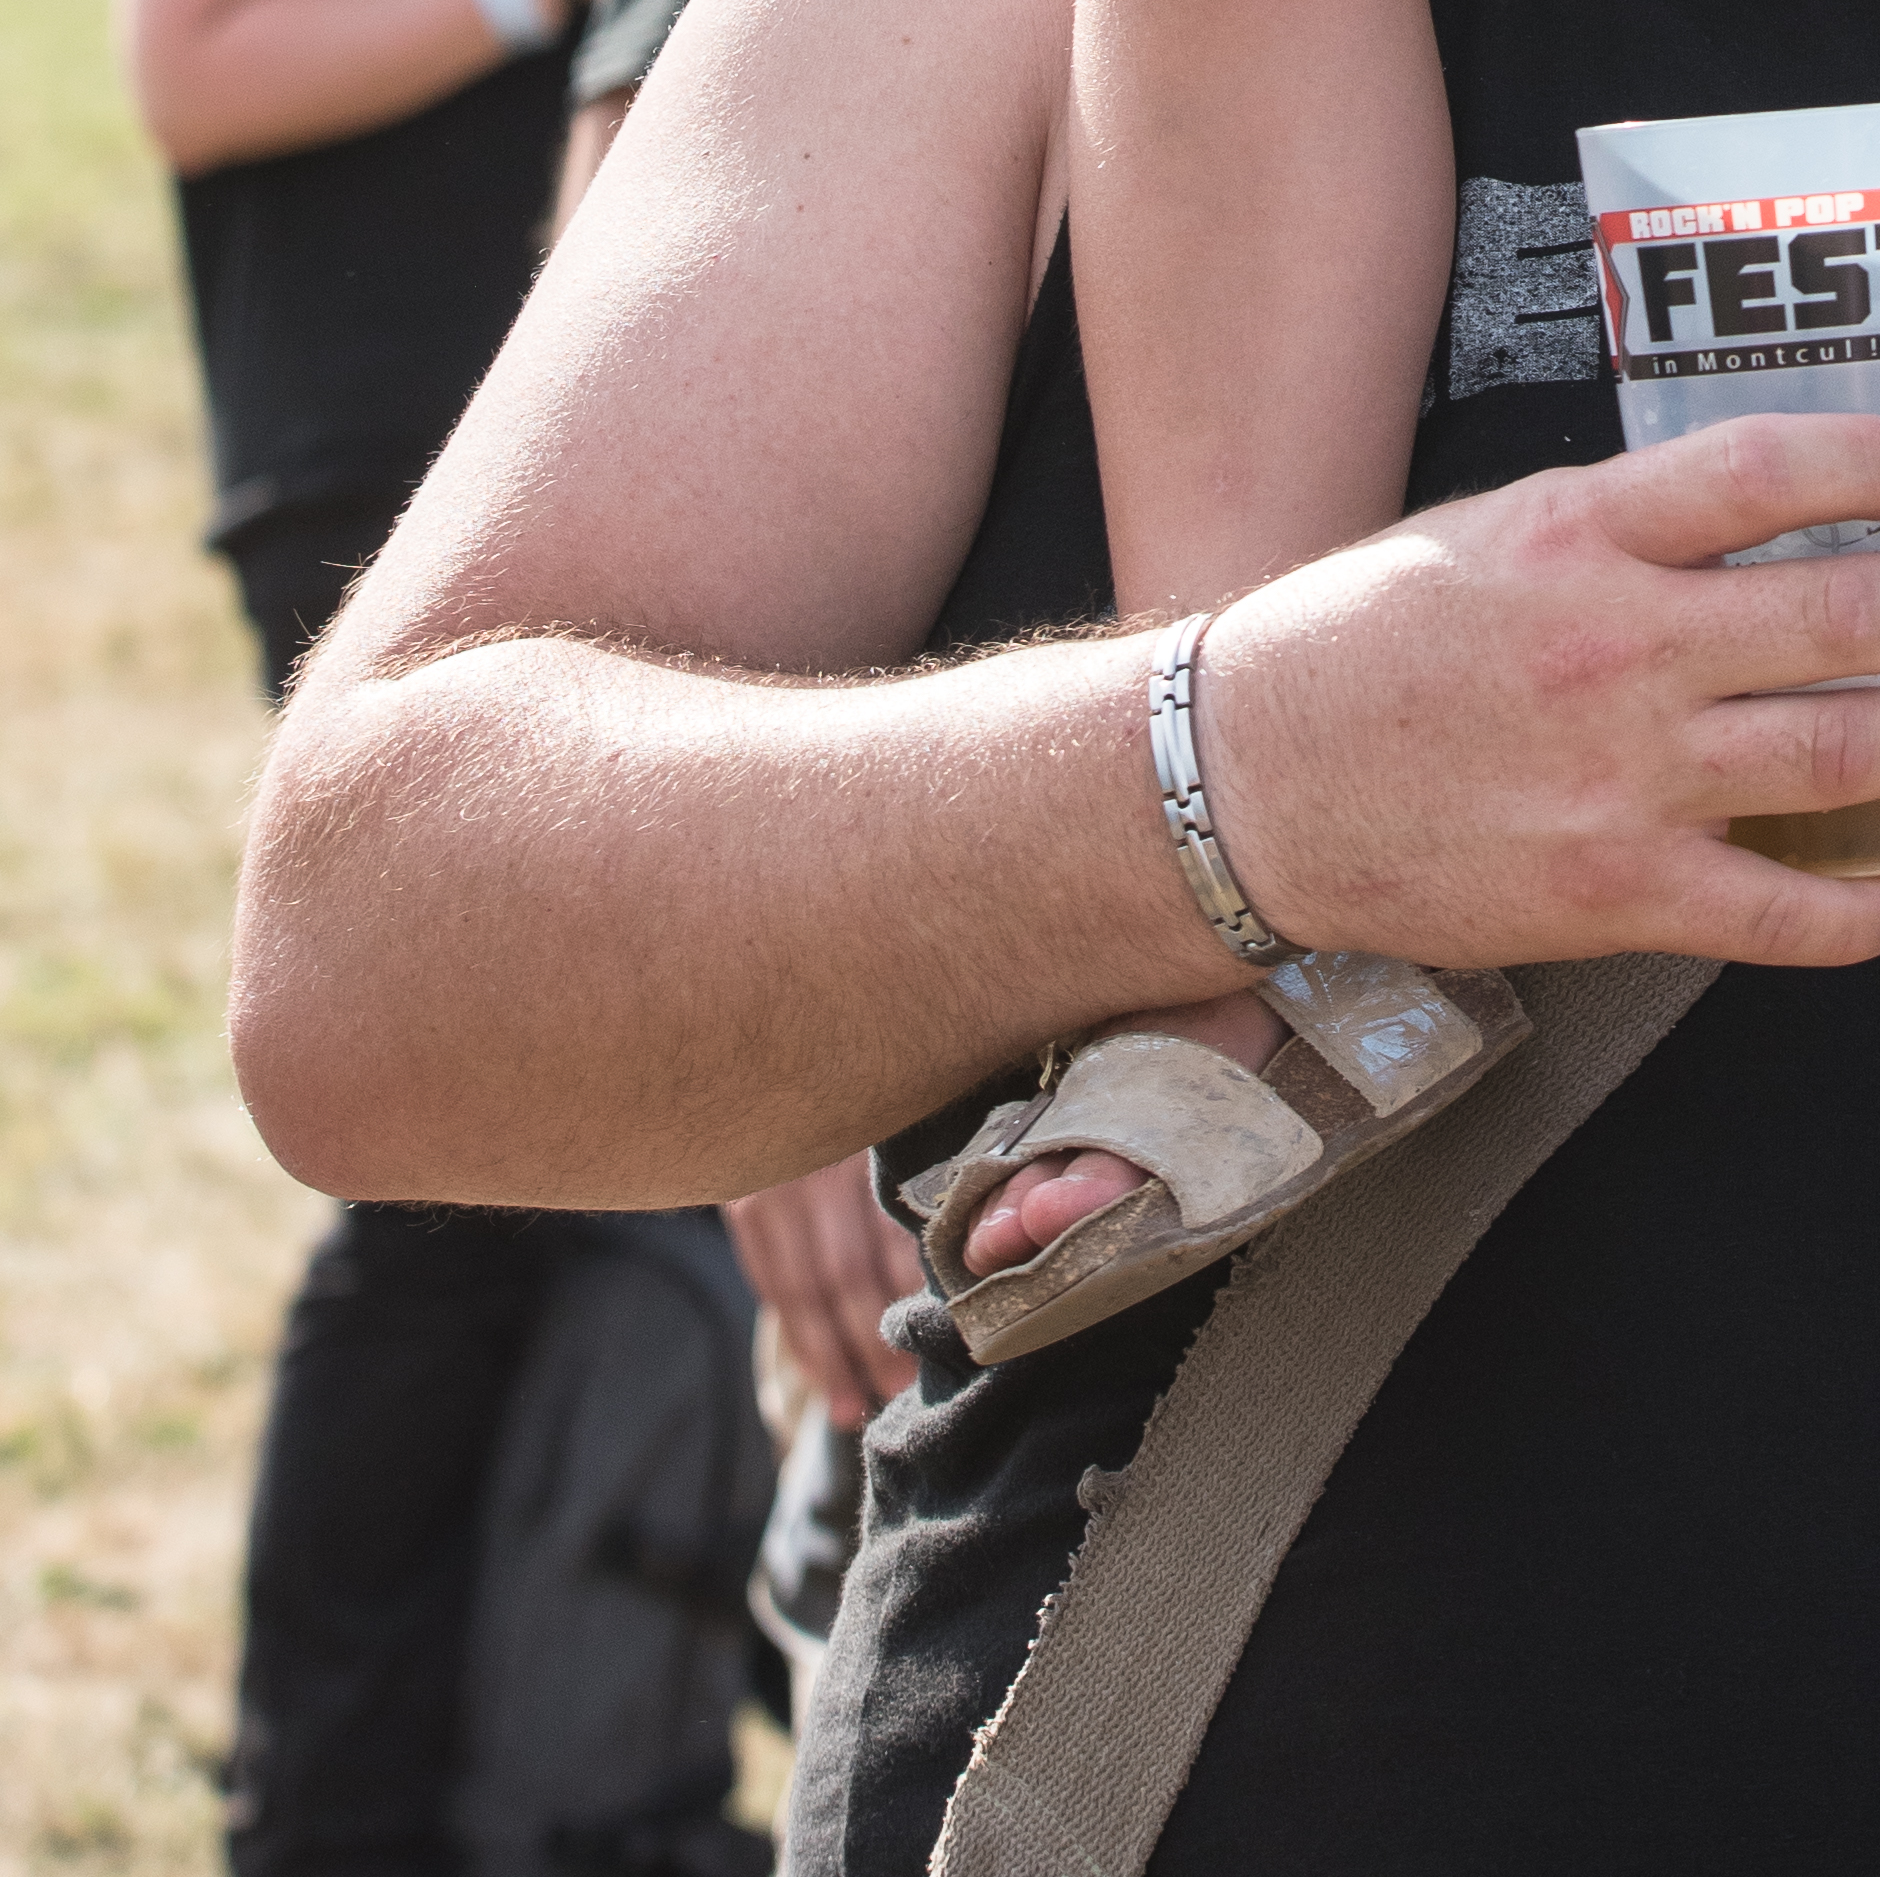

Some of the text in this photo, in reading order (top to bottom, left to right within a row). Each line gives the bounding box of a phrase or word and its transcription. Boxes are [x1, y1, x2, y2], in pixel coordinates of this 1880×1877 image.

[1629, 192, 1865, 241] ROCK'N POP
[1652, 356, 1679, 376] in
